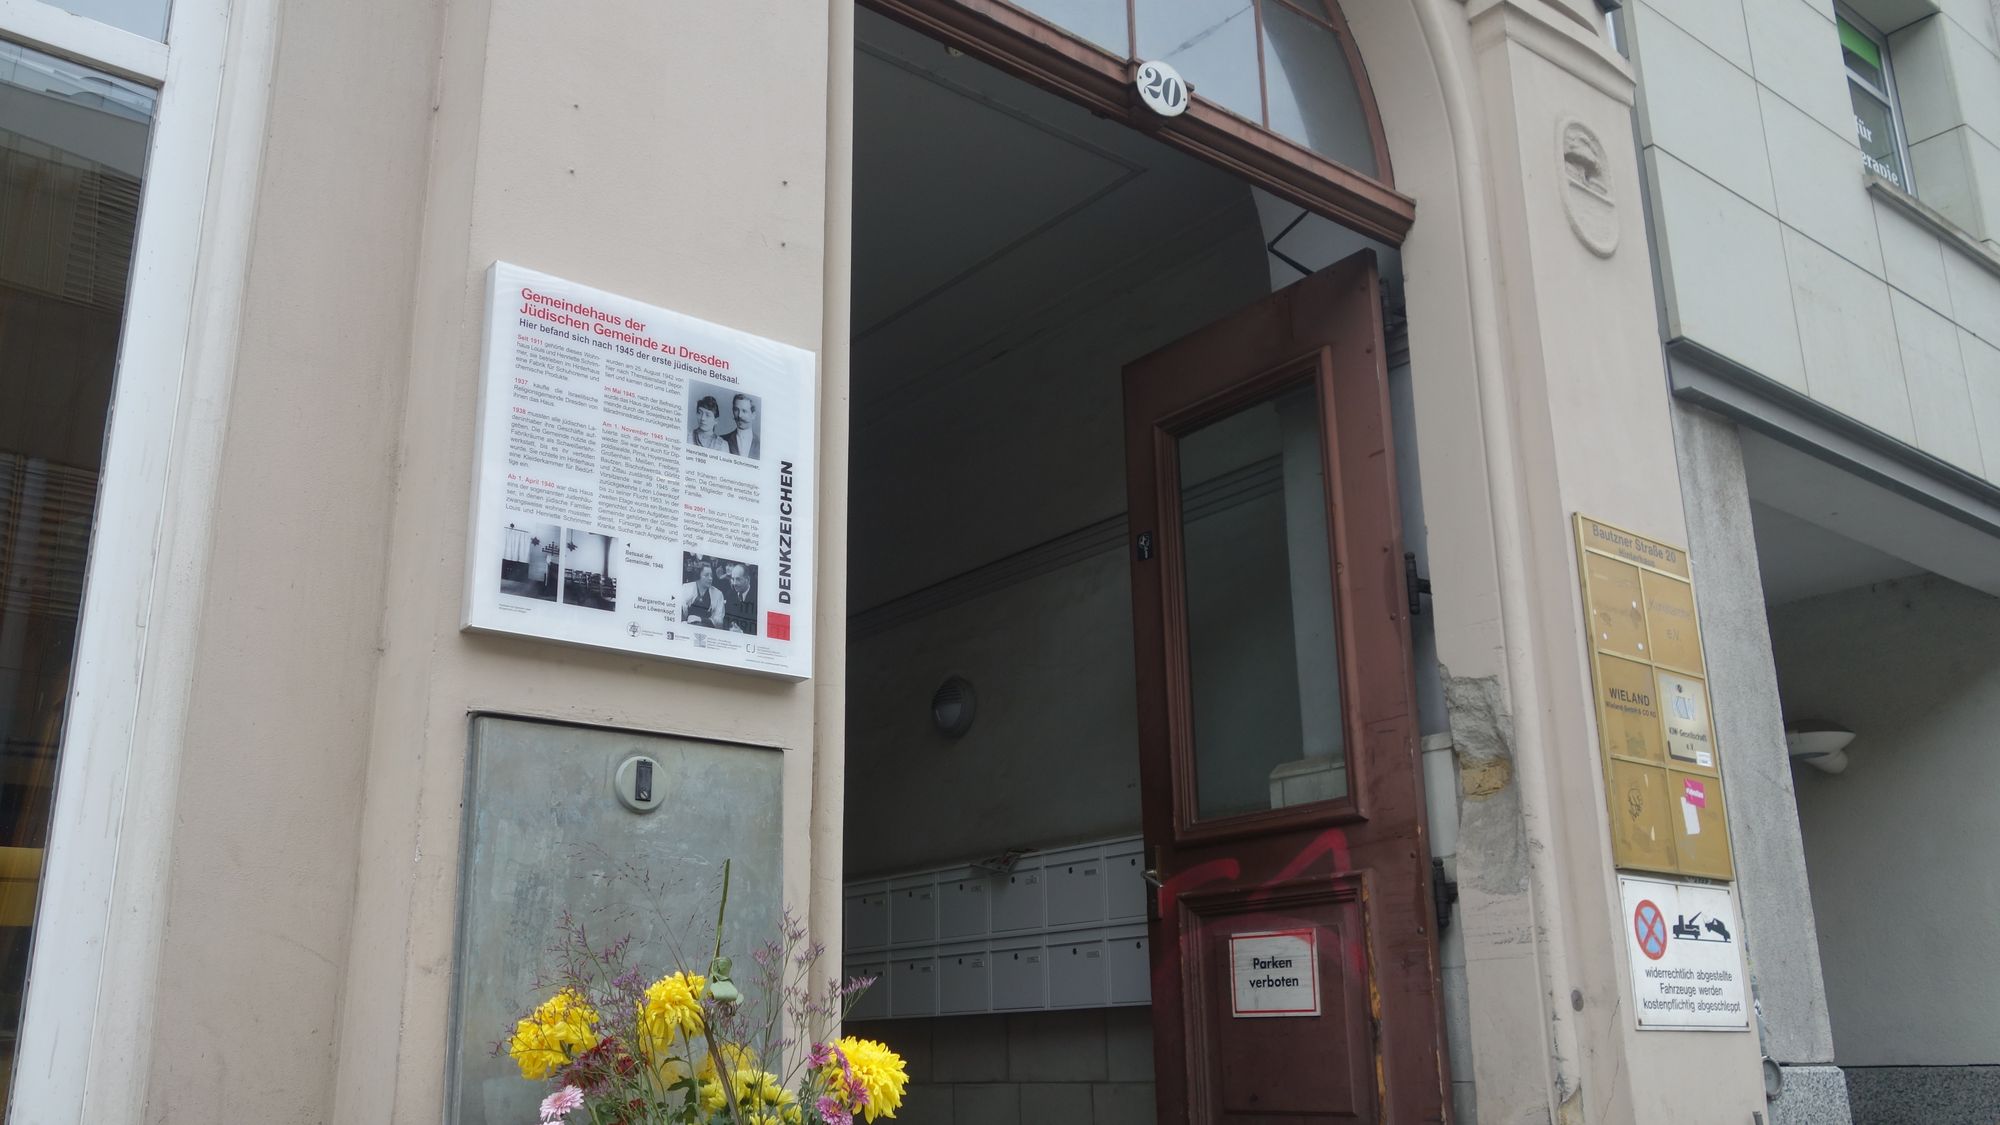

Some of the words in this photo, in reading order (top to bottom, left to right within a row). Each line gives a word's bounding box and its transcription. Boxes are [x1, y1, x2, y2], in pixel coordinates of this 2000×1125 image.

[1144, 67, 1181, 107] 20
[521, 287, 621, 325] Gemeindehaus
[625, 315, 645, 332] der
[519, 301, 589, 332] Jüdischen
[593, 321, 658, 350] Gemeinde
[662, 339, 676, 355] zu
[679, 345, 729, 369] Dresden
[530, 337, 542, 345] 1911
[519, 318, 536, 330] Hier
[539, 323, 569, 339] befand
[571, 332, 589, 344] sich
[592, 337, 612, 350] nach
[615, 343, 634, 355] 1945
[636, 349, 649, 360] der
[652, 353, 671, 365] erste
[673, 358, 707, 375] jüdische
[709, 368, 740, 384] Betsaal.
[514, 377, 527, 385] 1937
[512, 406, 525, 414] 1938
[621, 425, 648, 436] November
[525, 476, 539, 485] April
[579, 488, 593, 496] Haus
[777, 460, 793, 604] DENKZEICHEN
[1592, 524, 1632, 547] Bautzner
[1635, 538, 1663, 559] Straße
[1665, 550, 1676, 563] 20
[633, 603, 645, 611] Leon
[1609, 688, 1650, 706] WIELAND
[1253, 956, 1292, 969] Parken
[1249, 975, 1299, 988] verboten
[1645, 968, 1694, 980] widerrechtlich
[1697, 970, 1732, 982] abgestellte
[1660, 983, 1696, 996] Fahrzeuge
[1698, 985, 1723, 996] werden
[1643, 998, 1695, 1013] kostenpflichtig
[1698, 999, 1741, 1012] abgeschleppt
